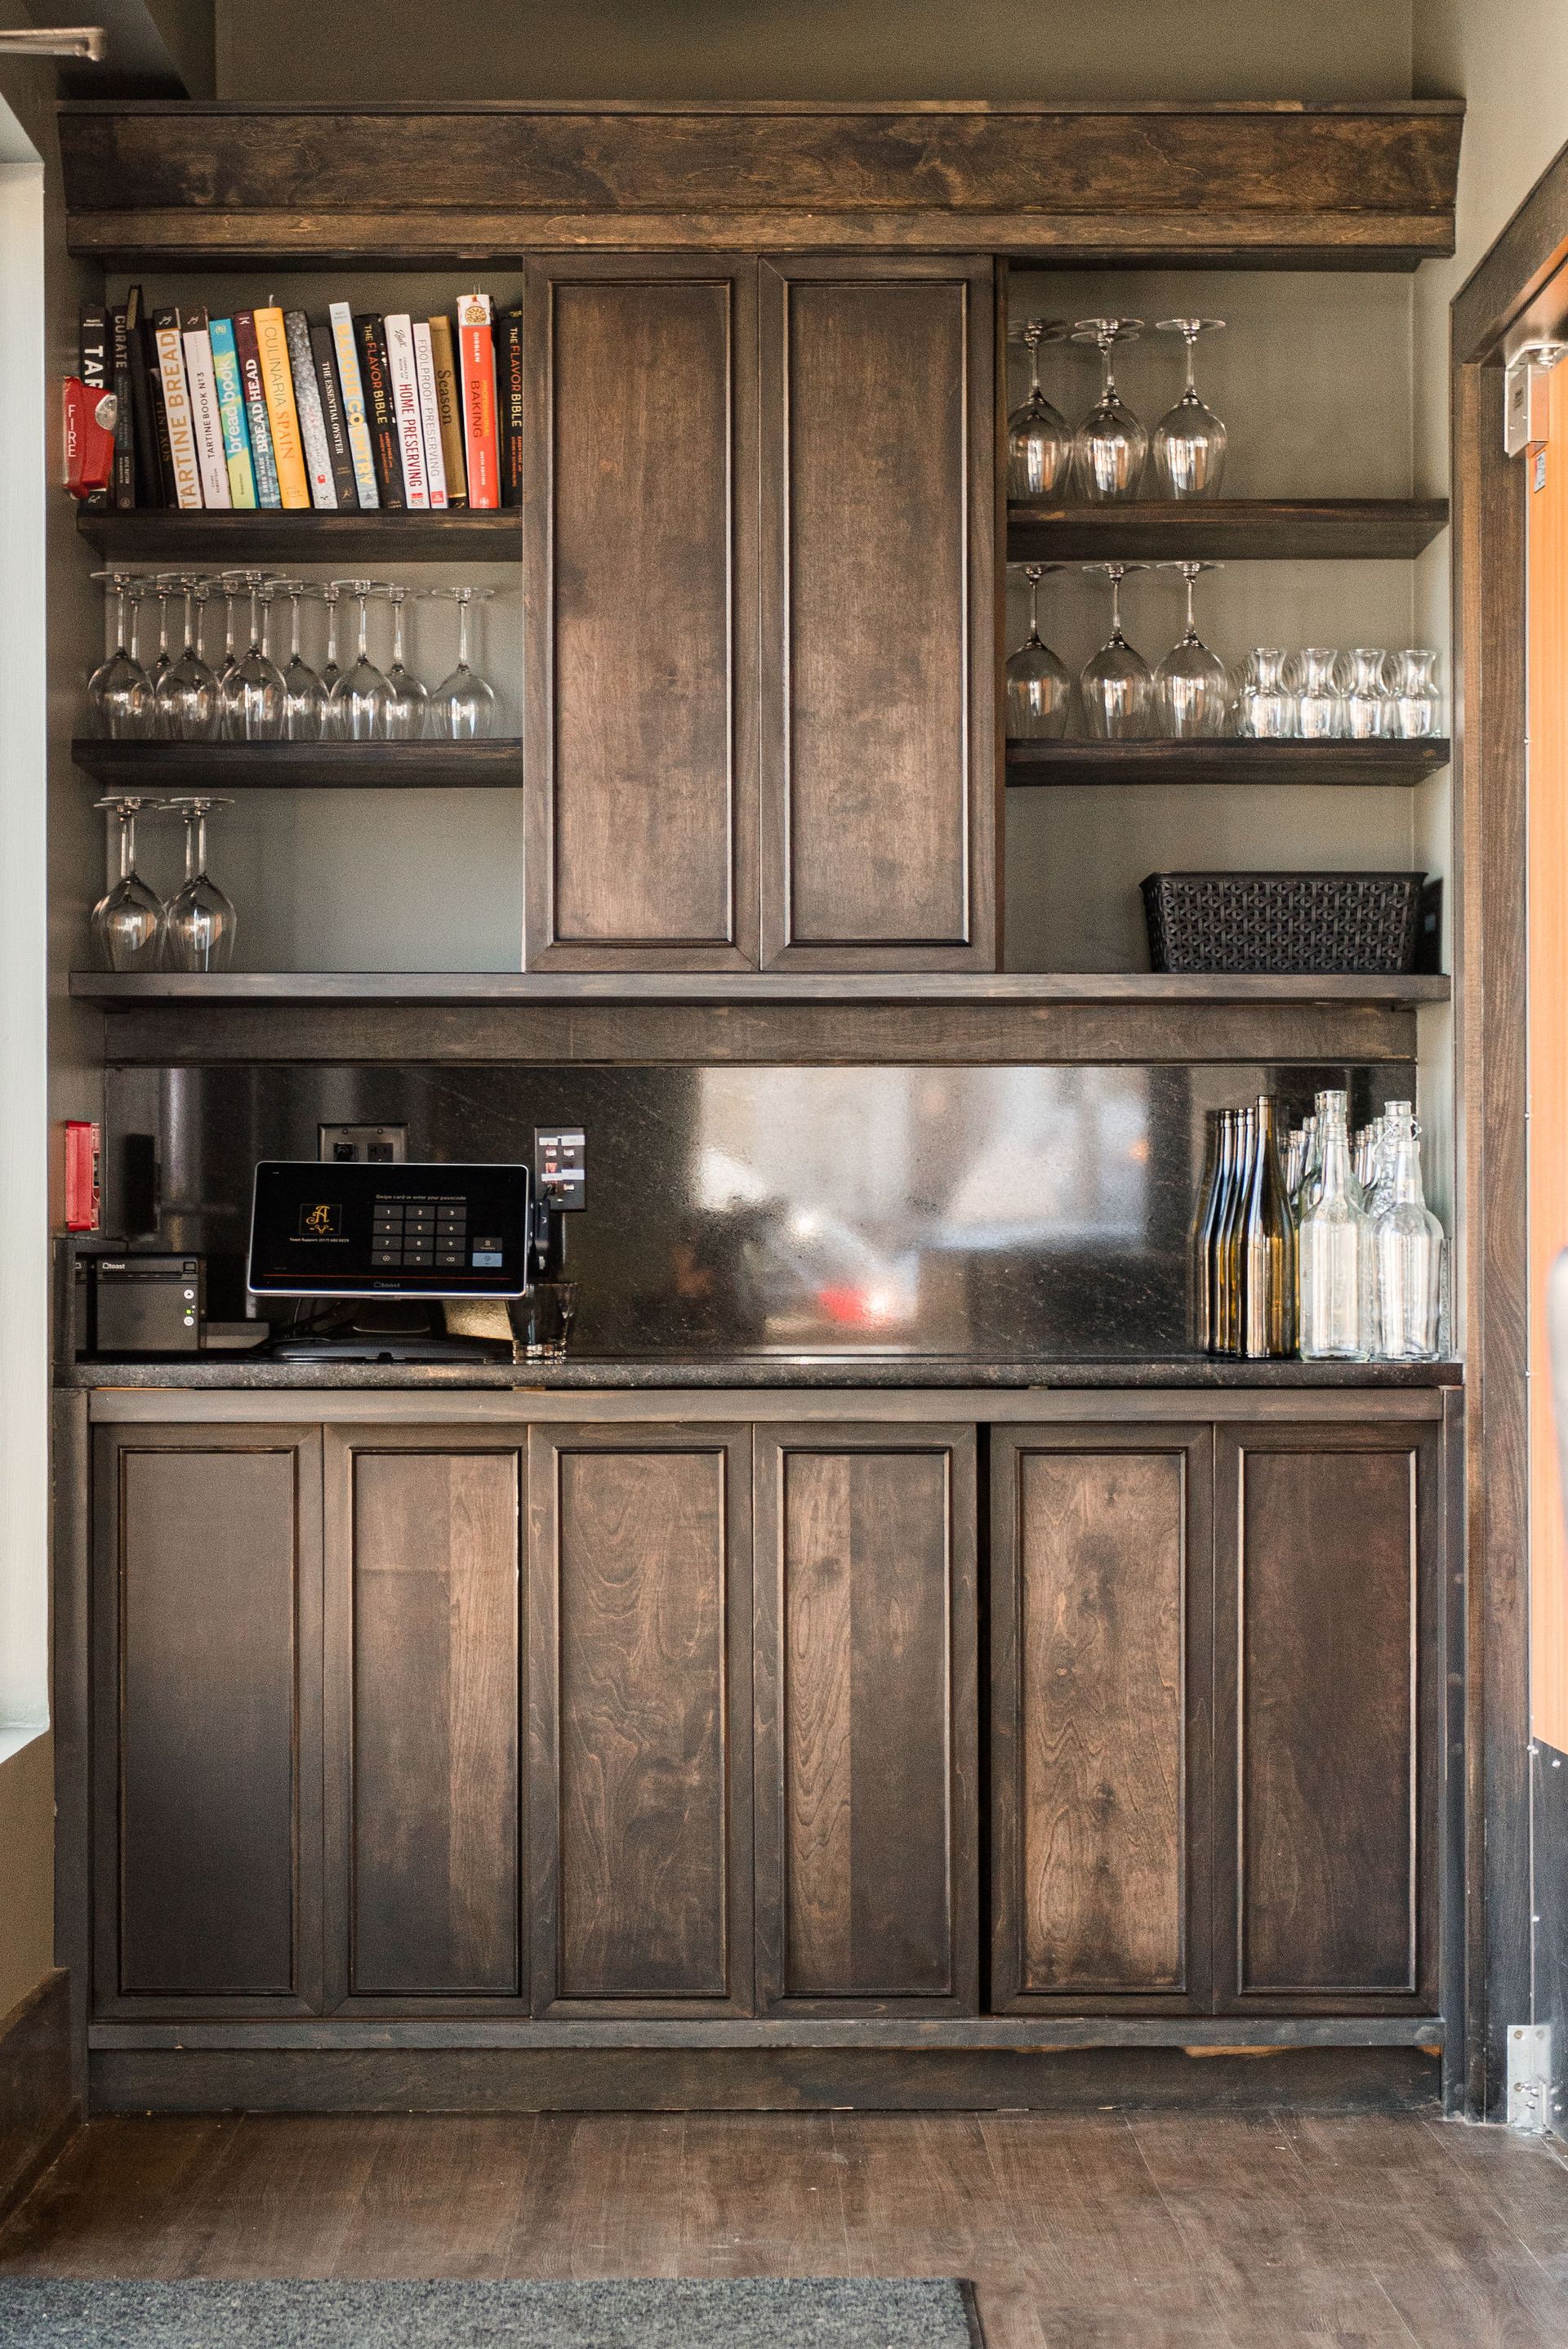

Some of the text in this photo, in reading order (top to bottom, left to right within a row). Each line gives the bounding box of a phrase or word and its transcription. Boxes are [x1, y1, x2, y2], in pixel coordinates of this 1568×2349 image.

[115, 315, 127, 368] CURATE
[322, 361, 332, 379] THE
[336, 324, 360, 397] BASQUE
[200, 393, 210, 419] BOOK
[246, 359, 268, 453] BREAD HEAD
[265, 327, 287, 408] CULINARIA
[278, 411, 294, 459] SPAIN
[324, 379, 339, 422] ESSENTIAL
[364, 325, 388, 424] THE FLAVOR BIBLE
[399, 384, 415, 414] HOME
[438, 370, 452, 425] Season
[510, 328, 523, 427] THE FLAVOR BIBLE
[68, 404, 77, 457] FIRE
[160, 332, 198, 508] TARTINE BREAD
[218, 360, 243, 453] bread book
[417, 339, 432, 403] FOOLPROOF
[425, 408, 439, 477] PRESERVING
[470, 381, 483, 439] BAKING
[203, 421, 215, 458] TARTINE
[332, 423, 344, 454] OYSTER
[347, 399, 373, 484] COUNTRY
[403, 419, 423, 487] PRESERVING
